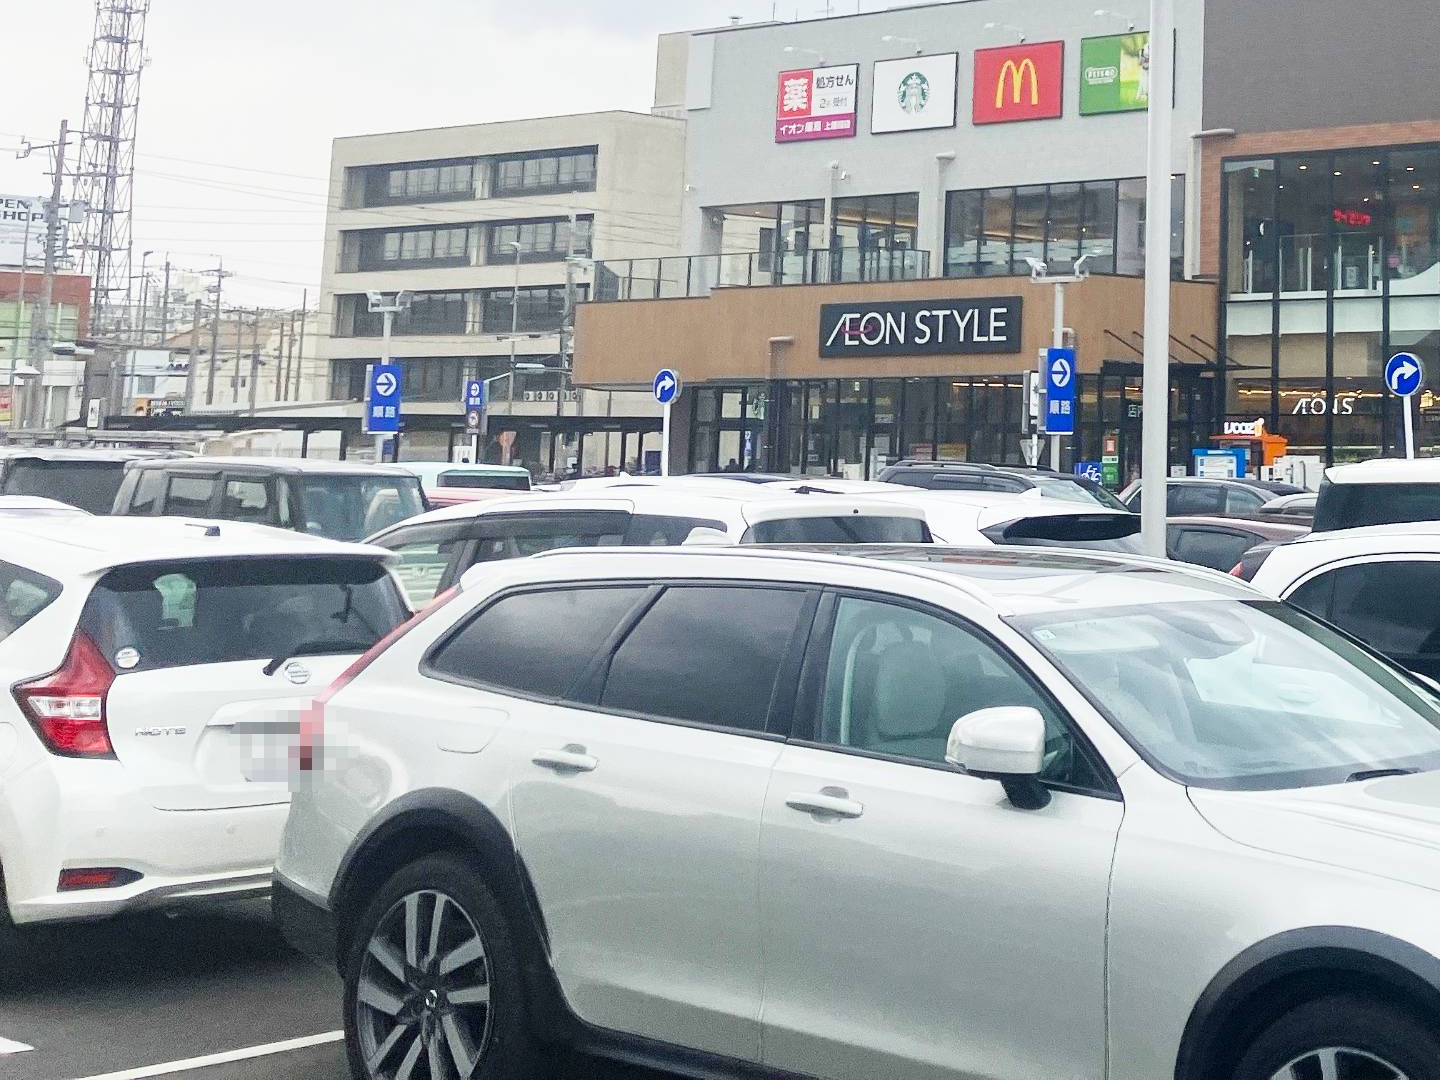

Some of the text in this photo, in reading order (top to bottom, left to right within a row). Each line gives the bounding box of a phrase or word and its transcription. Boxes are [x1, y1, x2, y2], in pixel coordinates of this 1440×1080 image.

[783, 78, 809, 111] 薬
[816, 74, 854, 89] 処方せん
[914, 307, 1008, 344] STYLE
